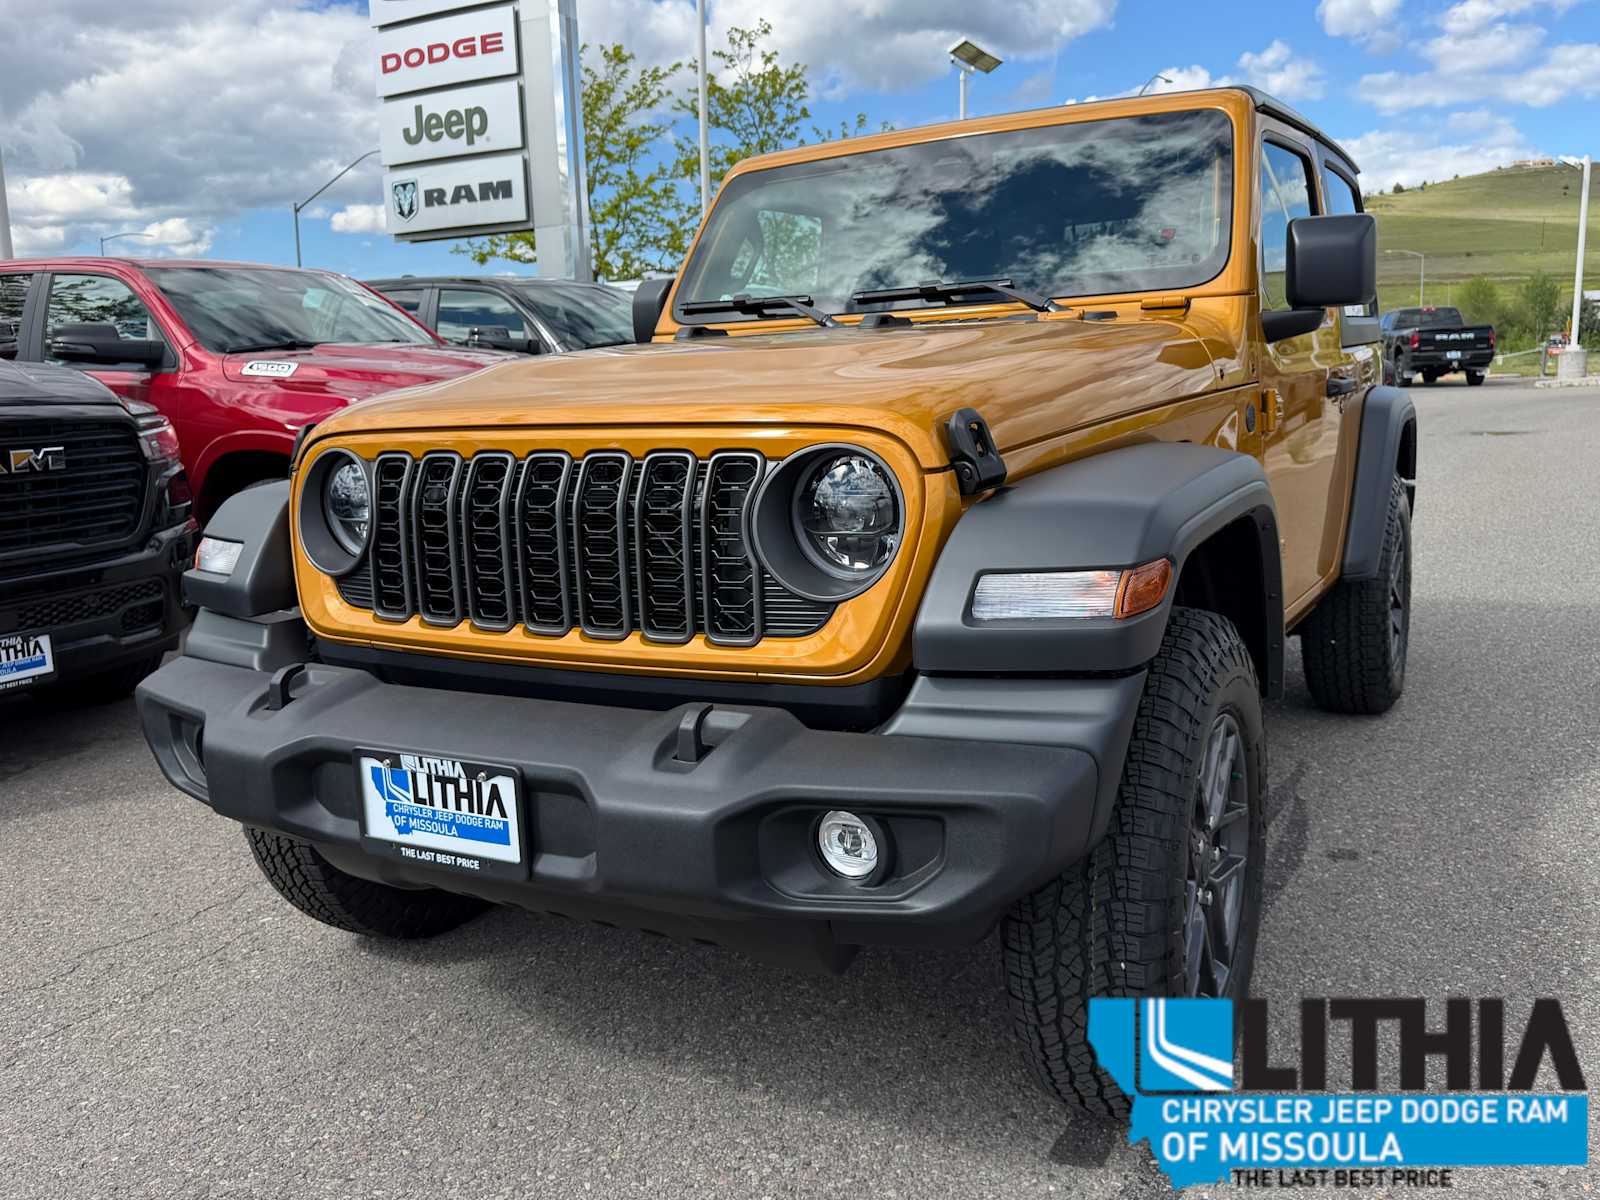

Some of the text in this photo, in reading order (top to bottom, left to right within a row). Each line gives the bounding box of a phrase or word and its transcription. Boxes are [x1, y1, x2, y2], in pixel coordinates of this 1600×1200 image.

[381, 32, 504, 75] DODGE
[402, 104, 488, 146] Jeep
[424, 180, 513, 208] RAM
[415, 755, 467, 779] LITHIA
[410, 771, 508, 819] LITHIA
[393, 803, 504, 831] CHRYSLER JEEP DODGE RAM
[394, 815, 459, 837] OF MISSOULA
[400, 847, 480, 870] THE LAST BEST PRICE
